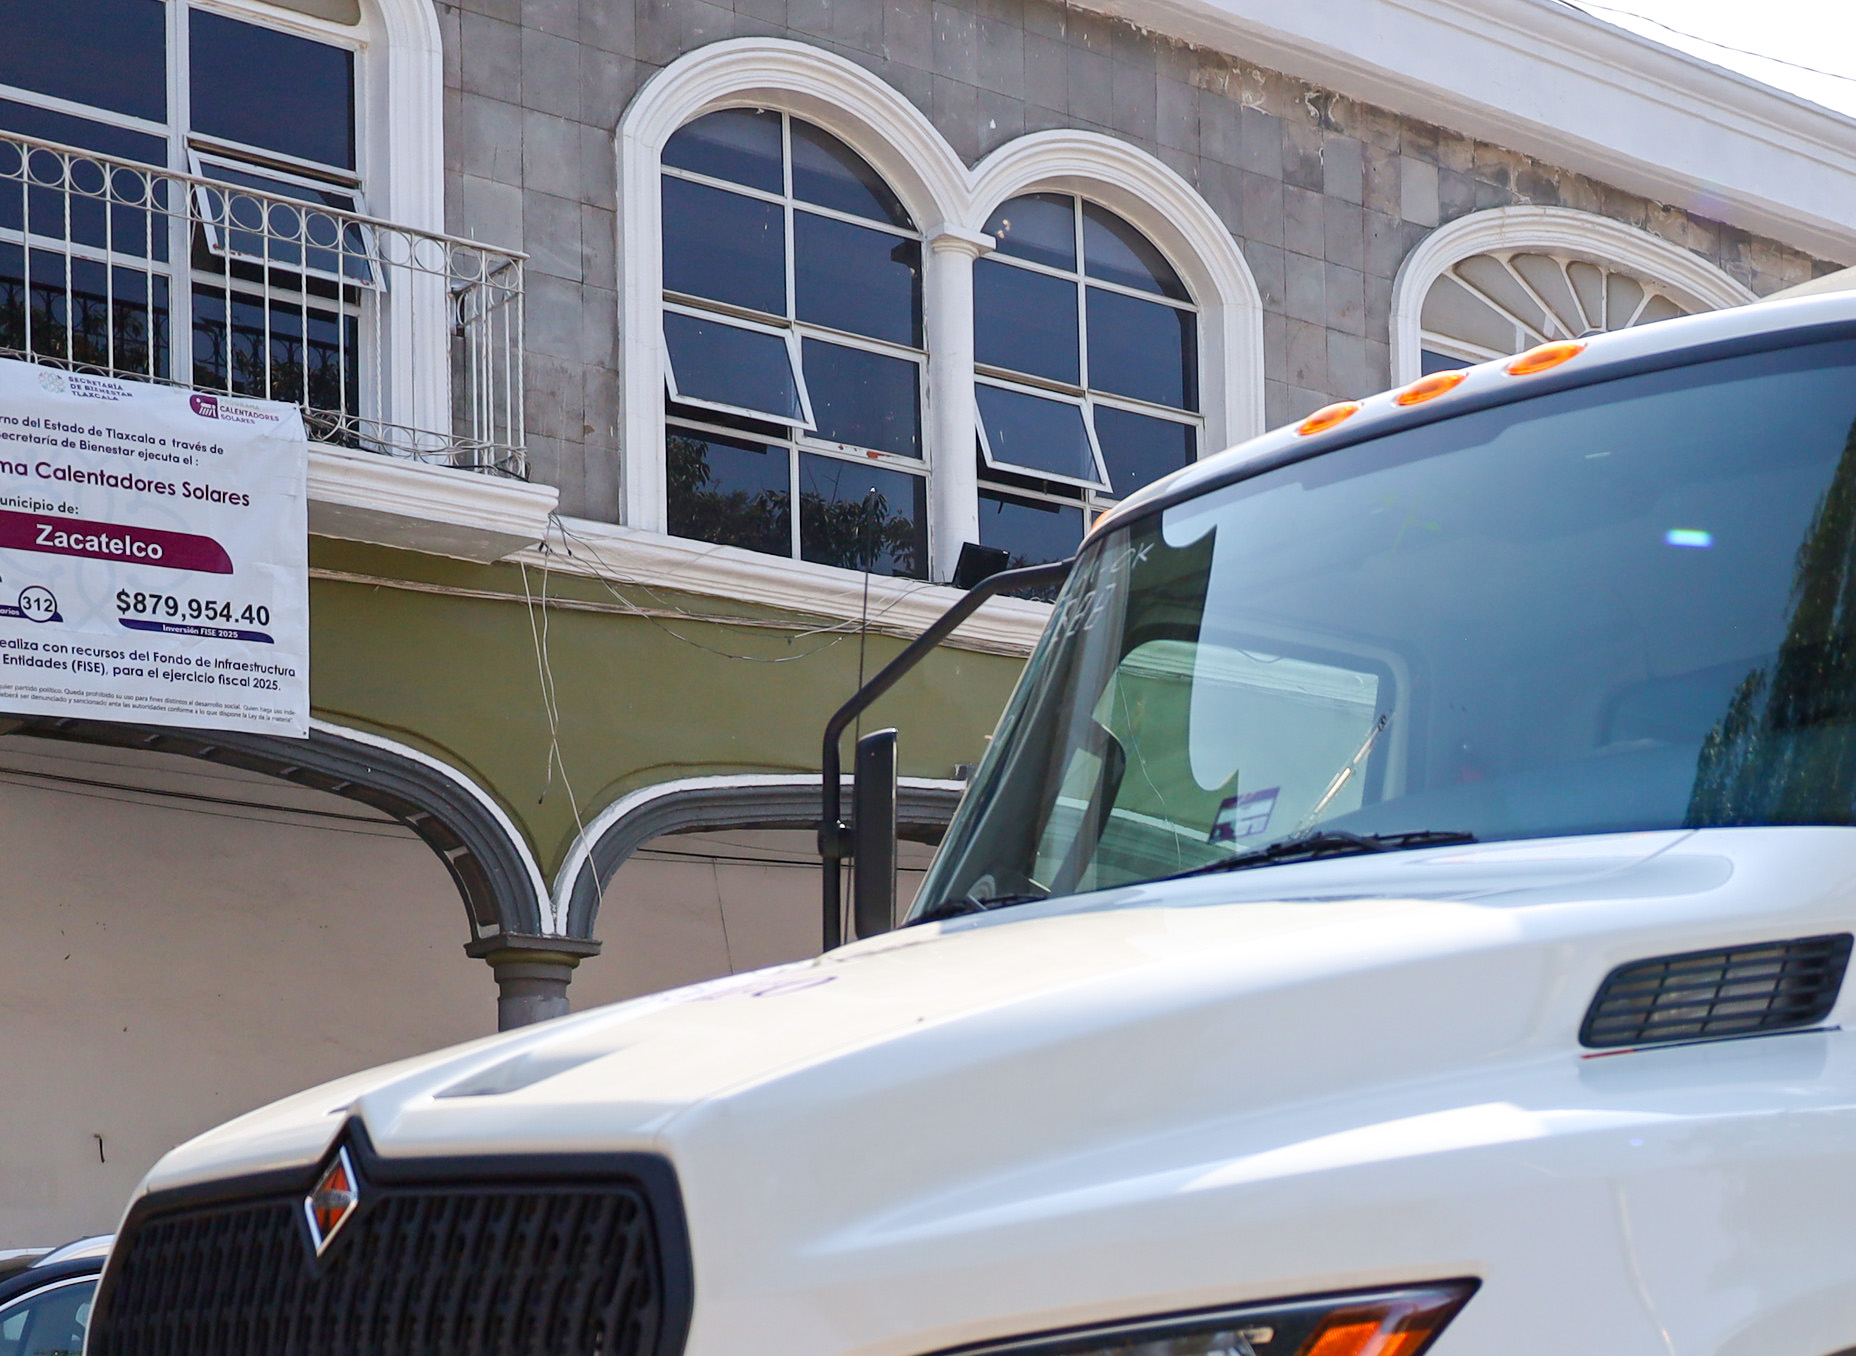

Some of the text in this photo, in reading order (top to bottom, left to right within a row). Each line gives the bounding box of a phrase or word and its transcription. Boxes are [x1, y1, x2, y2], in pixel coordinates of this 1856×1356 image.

[68, 376, 124, 391] SECRETARÍA
[84, 384, 133, 398] BIENESTAR
[71, 390, 119, 401] TLAXCALA
[220, 405, 280, 422] CALENTADORES
[220, 413, 256, 424] SOLARES
[22, 416, 41, 428] del
[44, 419, 85, 434] Estado
[87, 426, 103, 437] de
[105, 427, 156, 445] Tlaxcala
[158, 438, 166, 446] a
[172, 438, 207, 453] través
[209, 444, 224, 455] de
[61, 437, 76, 449] de
[79, 440, 135, 457] Bienestar
[138, 448, 180, 463] ejecuta
[183, 455, 193, 466] el
[35, 461, 176, 496] Calentadores
[182, 481, 250, 507] Solares
[58, 501, 79, 515] de:
[35, 523, 163, 560] Zacatelco
[22, 595, 54, 613] 312
[116, 588, 270, 627] $879,954.40
[162, 624, 239, 639] Inversión FISE 2025
[42, 643, 68, 655] con
[71, 646, 125, 660] recursos
[129, 650, 149, 661] del
[153, 652, 192, 666] Fondo
[195, 656, 211, 668] de
[214, 658, 296, 677] Infraestructura
[2, 653, 281, 691] Entidades (FISE), para el ejercicio fiscal 2025.
[64, 688, 84, 696] Queda
